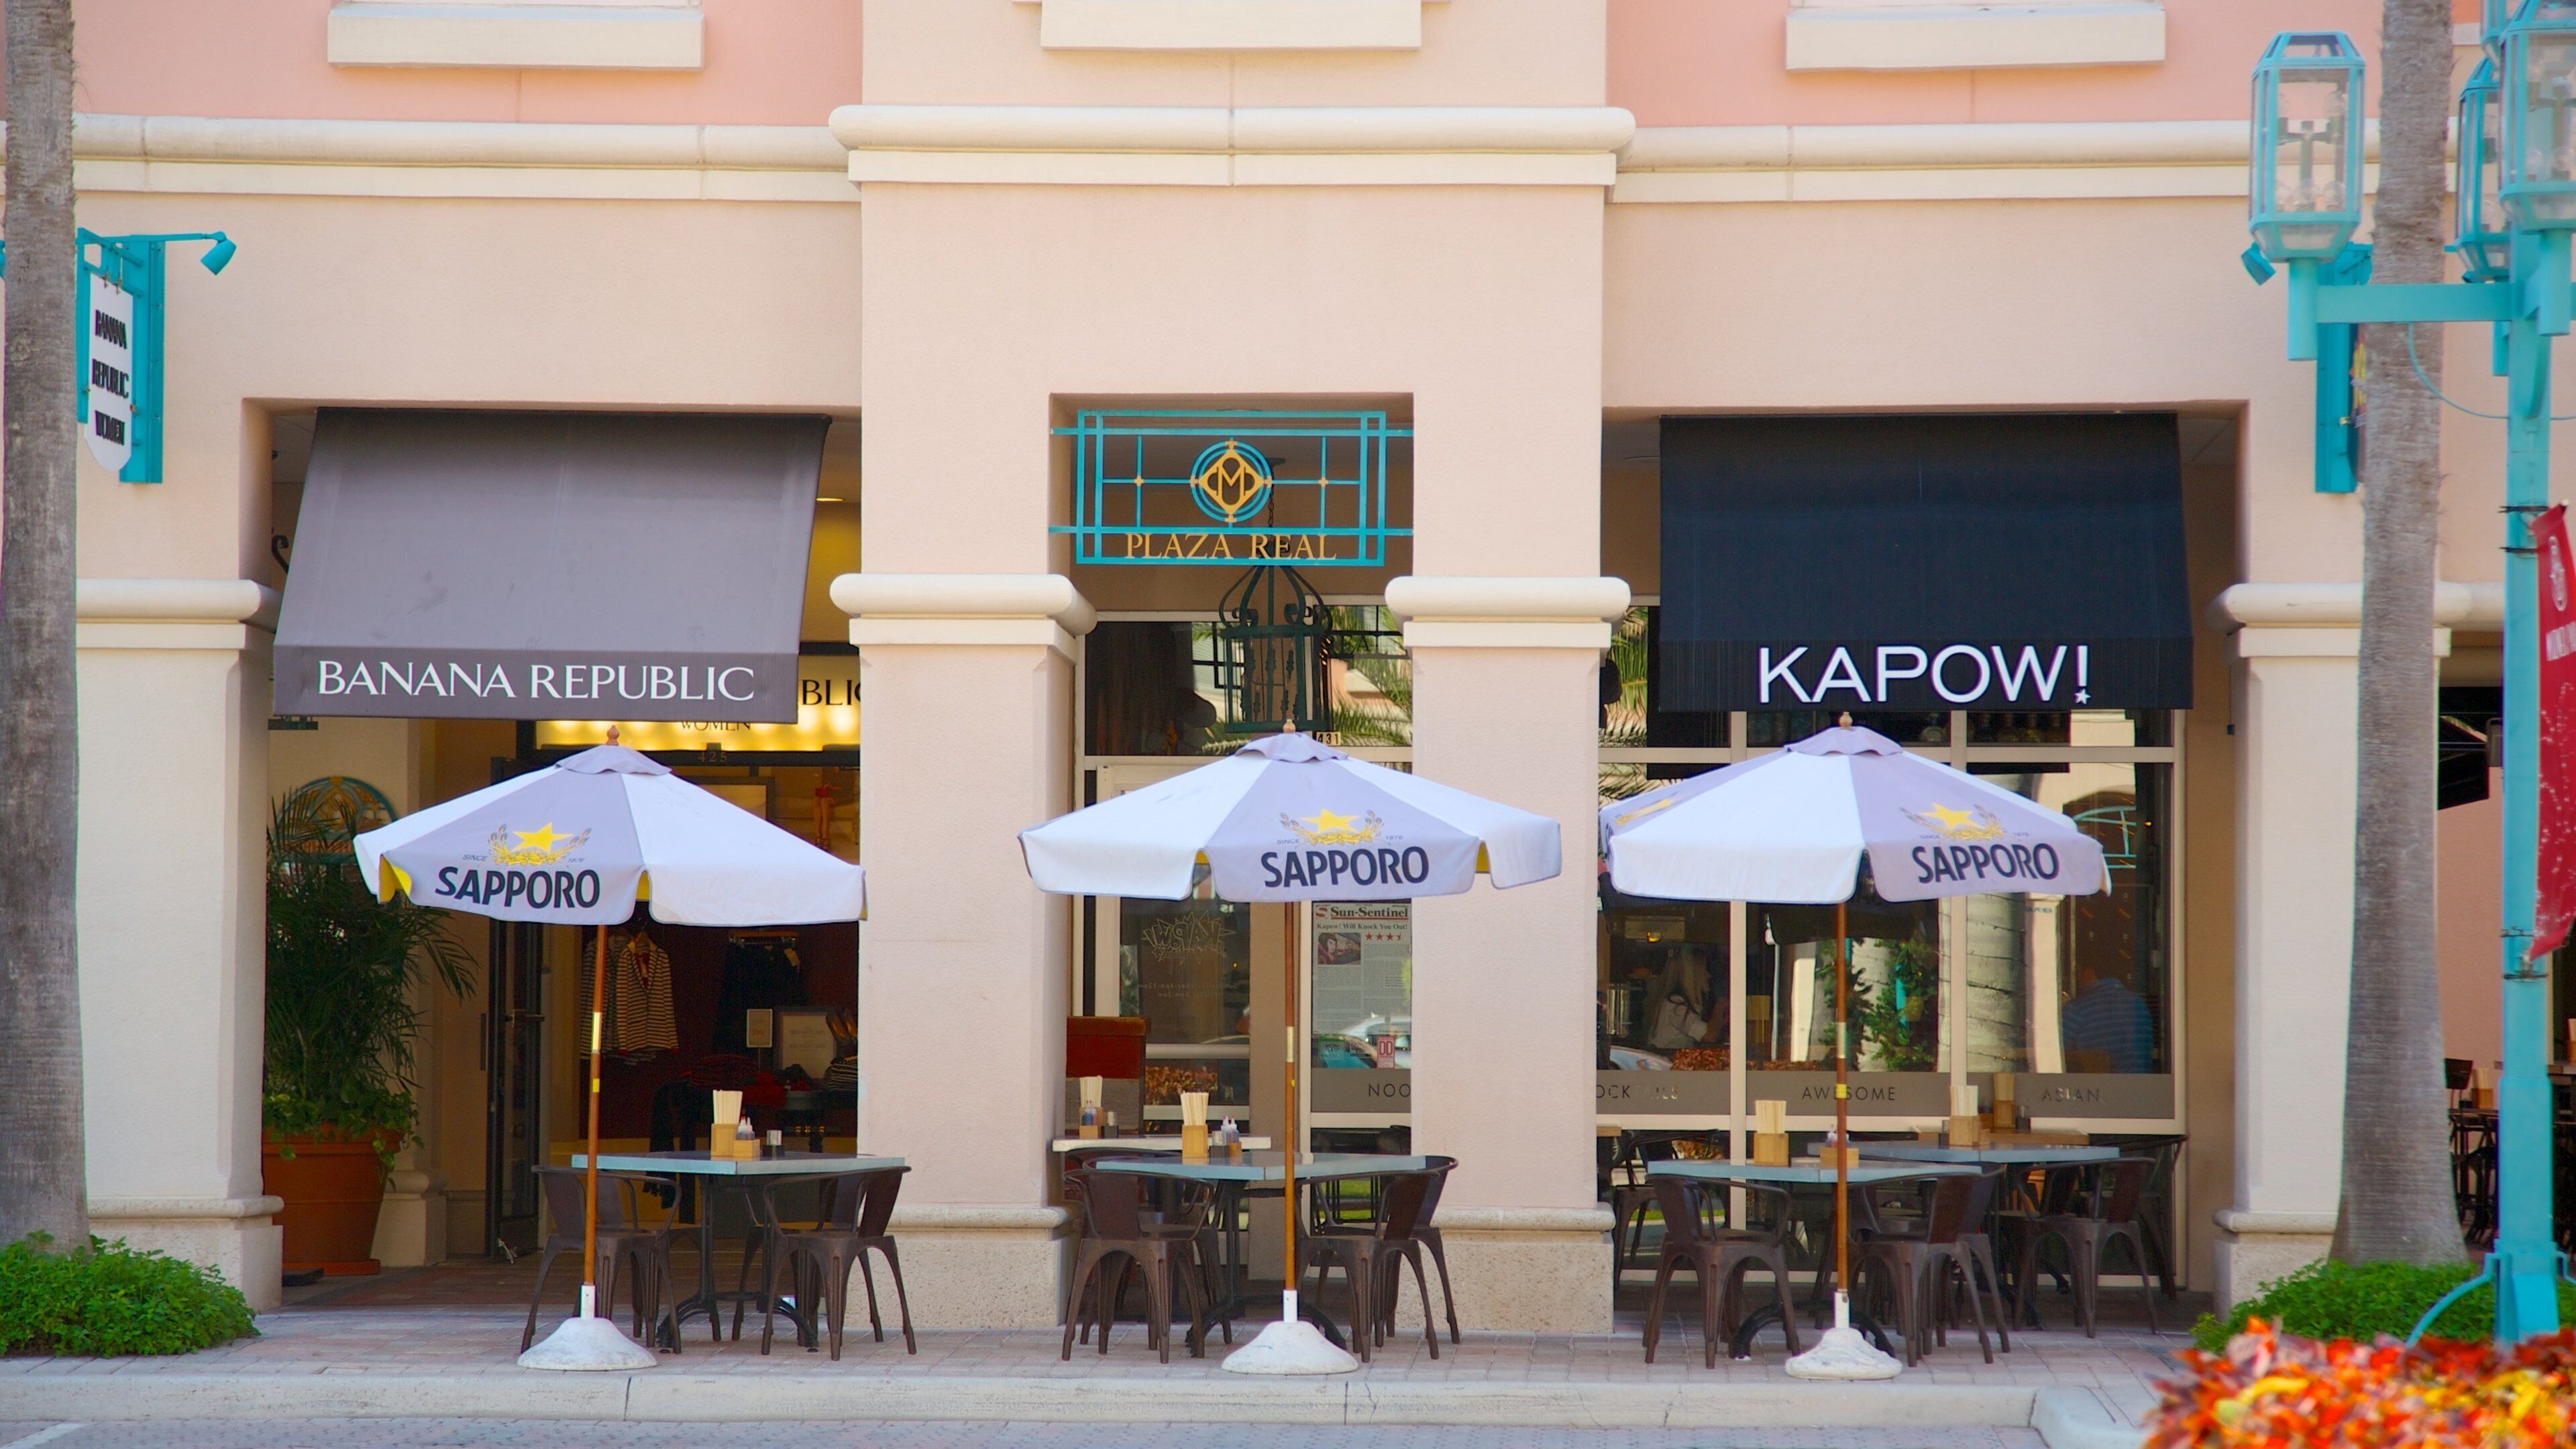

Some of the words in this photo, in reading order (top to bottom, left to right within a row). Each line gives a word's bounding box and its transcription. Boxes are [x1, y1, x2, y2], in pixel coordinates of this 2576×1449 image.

[95, 309, 127, 350] BANANA
[92, 358, 129, 399] REPUBLIC
[95, 409, 125, 446] WOMEN
[1124, 533, 1234, 560] PLAZA
[1248, 534, 1336, 560] REAL
[317, 660, 517, 698] BANANA
[531, 664, 755, 702] REPUBLIC
[1758, 644, 2092, 705] KAPOW!
[698, 751, 727, 763] 425
[1318, 733, 1339, 745] 431
[462, 853, 488, 862] SINCE
[1260, 846, 1430, 888] SAPPORO
[1912, 843, 2059, 884] SAPPORO
[435, 866, 600, 909] SAPPORO
[1330, 906, 1409, 918] Sun-Sentinel
